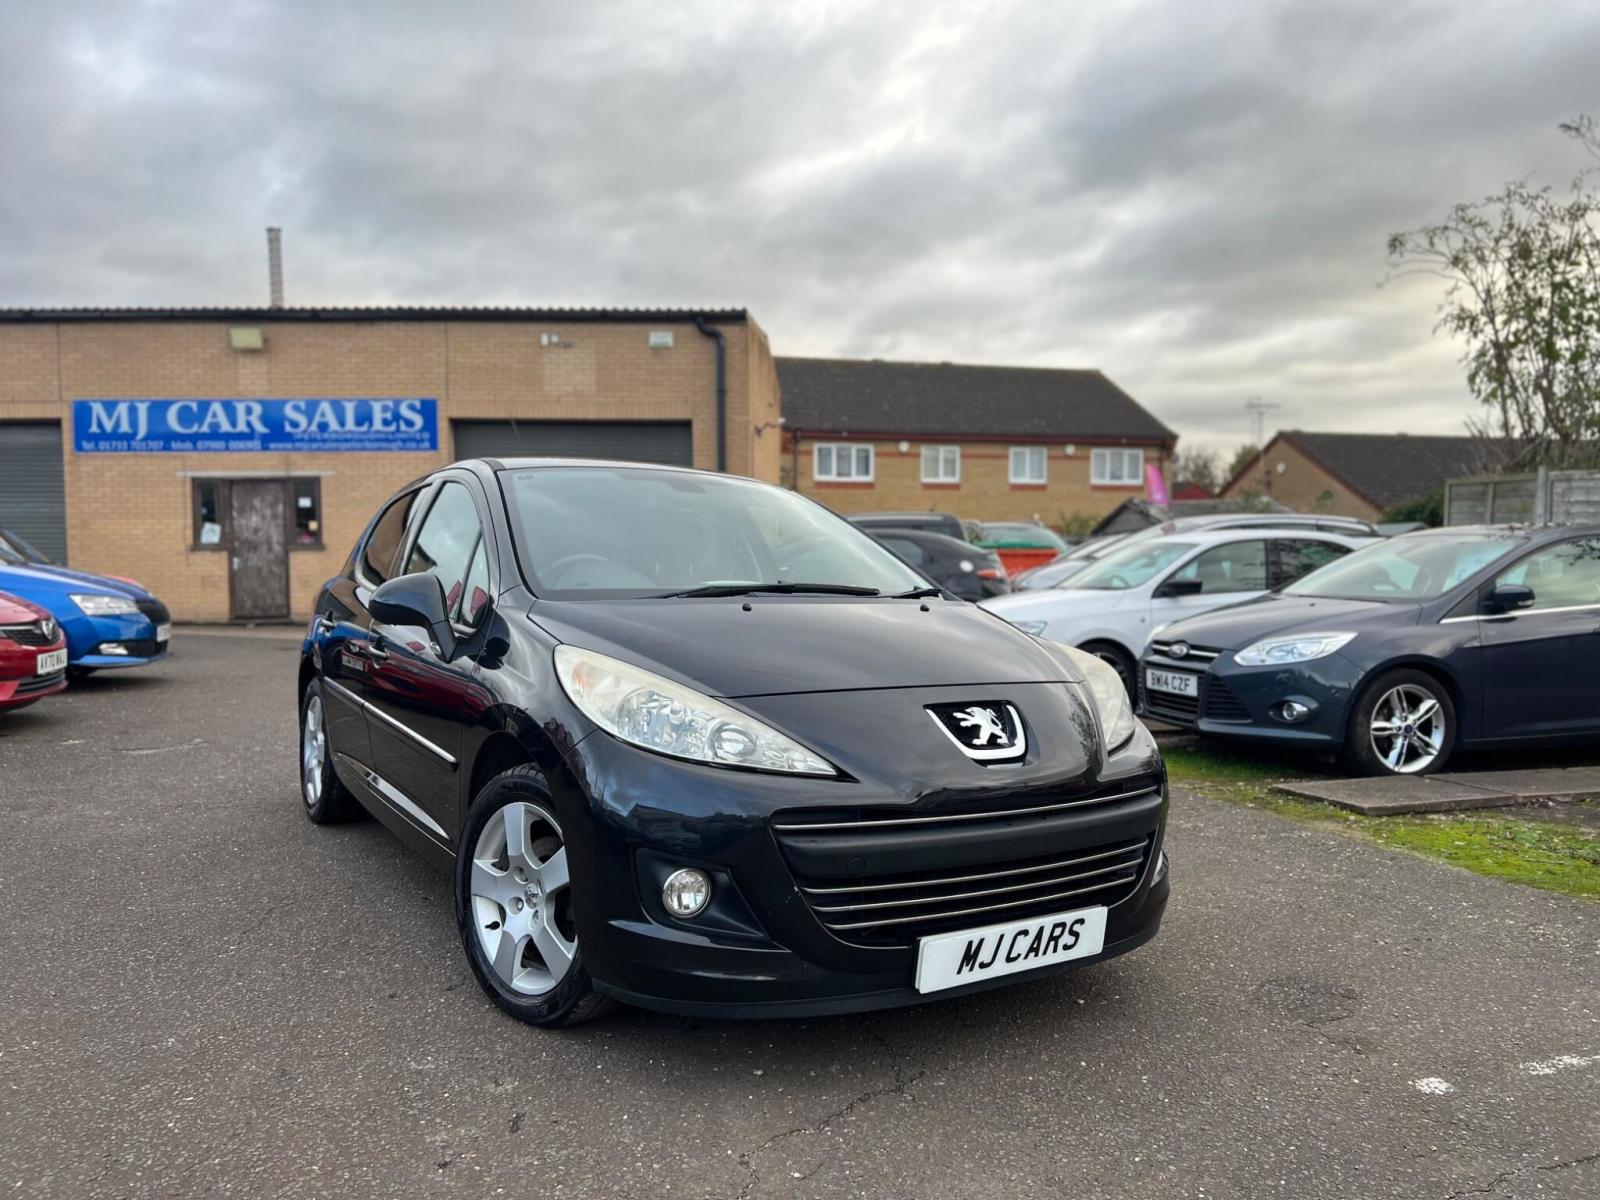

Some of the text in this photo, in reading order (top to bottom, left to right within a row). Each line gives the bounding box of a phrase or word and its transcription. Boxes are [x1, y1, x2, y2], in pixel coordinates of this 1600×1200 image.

[88, 400, 424, 440] MJ CAR SALES
[1171, 676, 1191, 692] CZF
